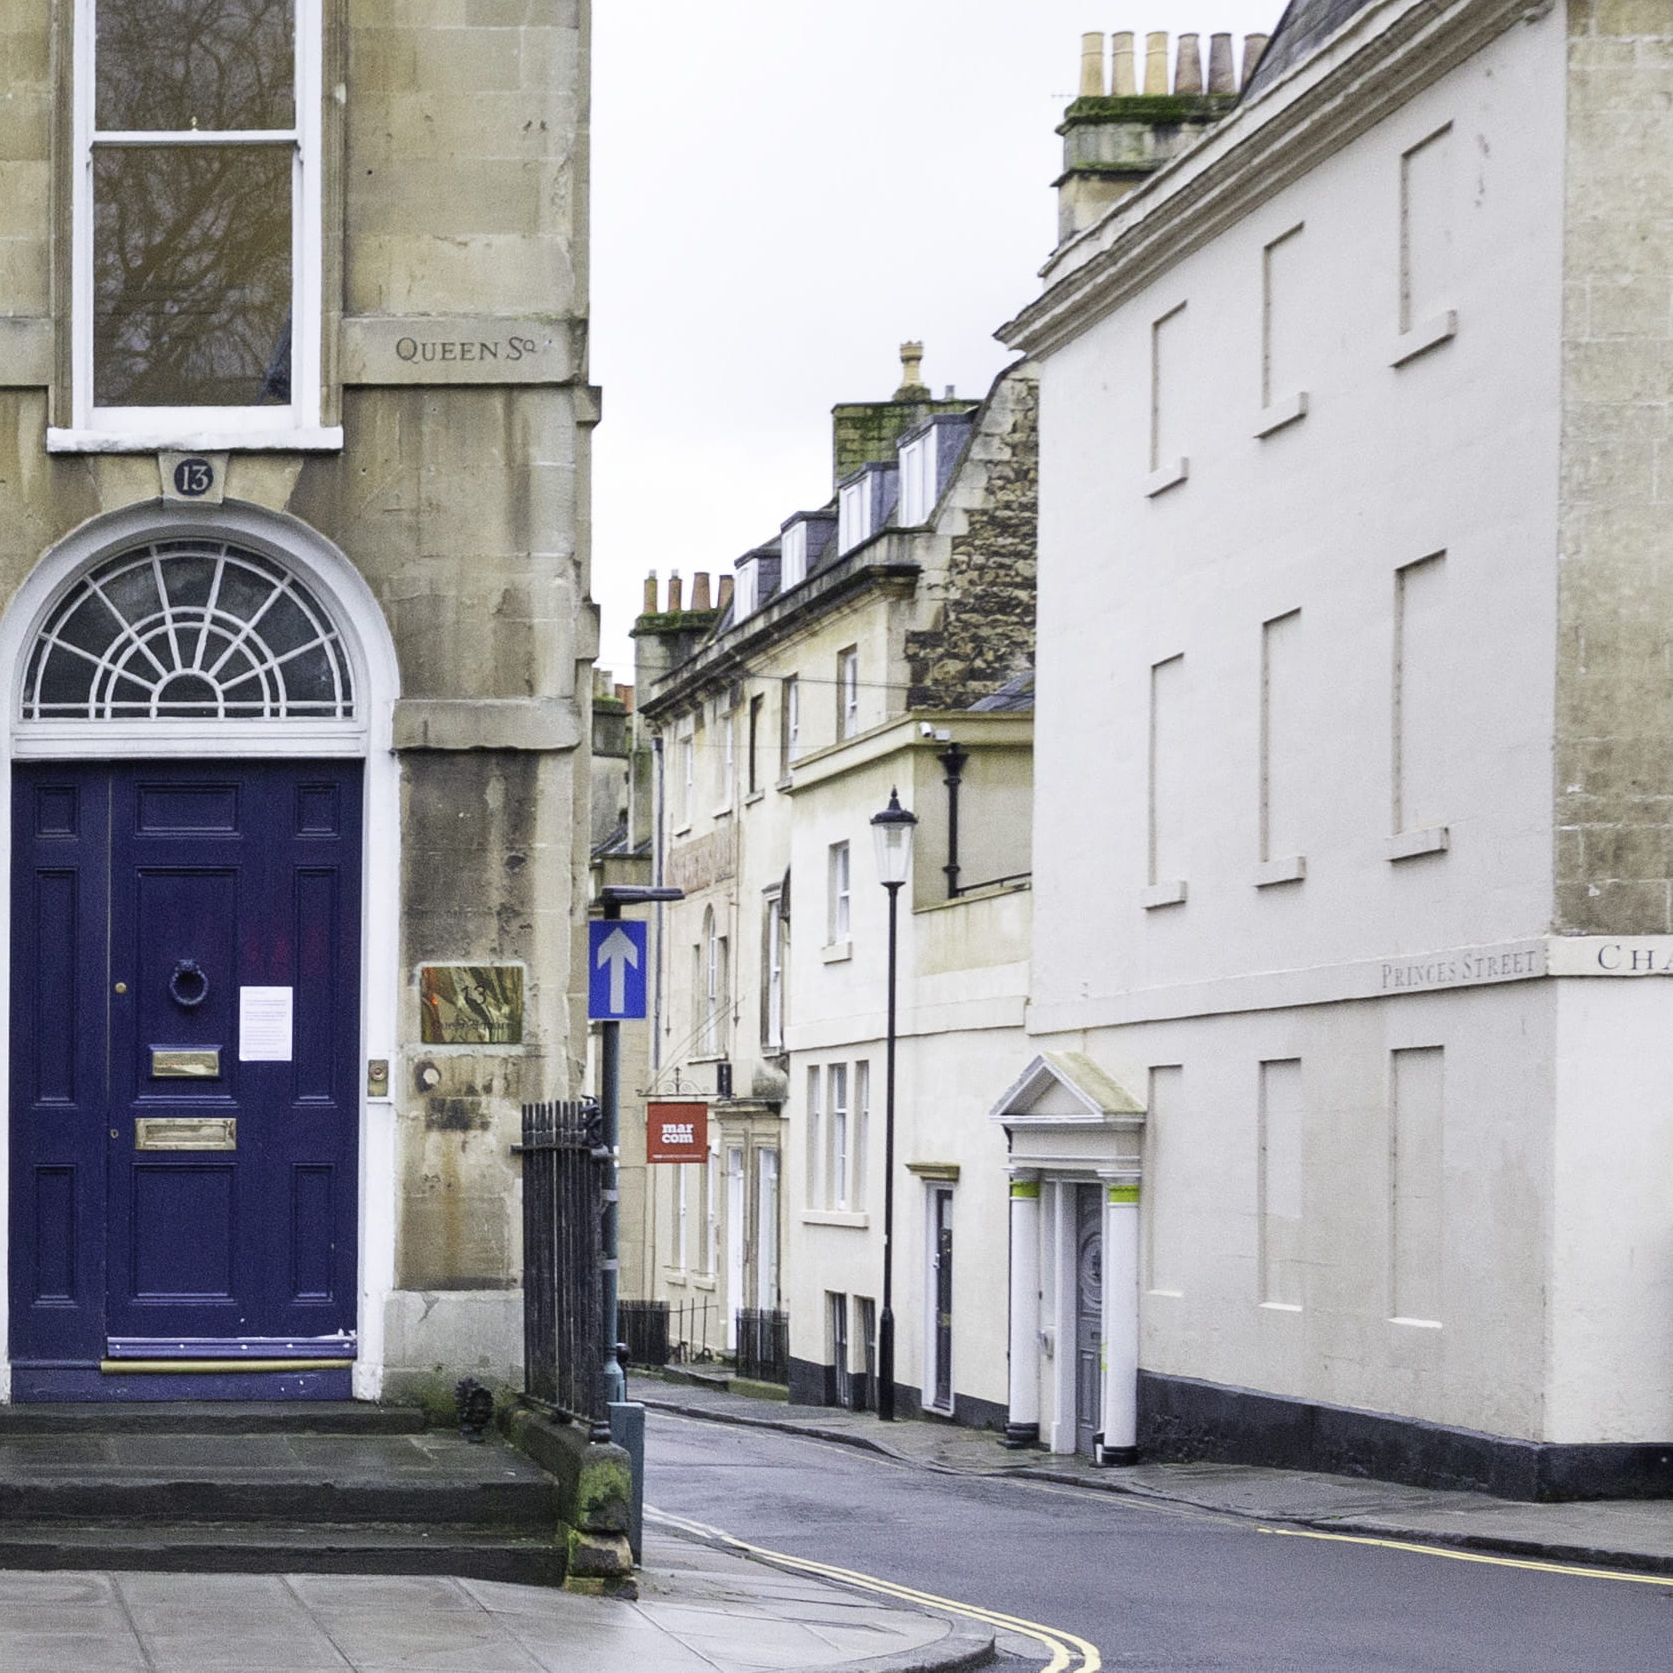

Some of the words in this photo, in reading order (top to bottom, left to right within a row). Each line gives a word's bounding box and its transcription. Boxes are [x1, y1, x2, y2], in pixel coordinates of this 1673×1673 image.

[395, 336, 499, 364] QUEEN
[182, 465, 209, 491] 13
[1381, 960, 1455, 989] PRINCES
[1462, 950, 1536, 980] STREET
[461, 984, 487, 1005] 13
[661, 1123, 694, 1134] mar
[661, 1133, 694, 1144] com
